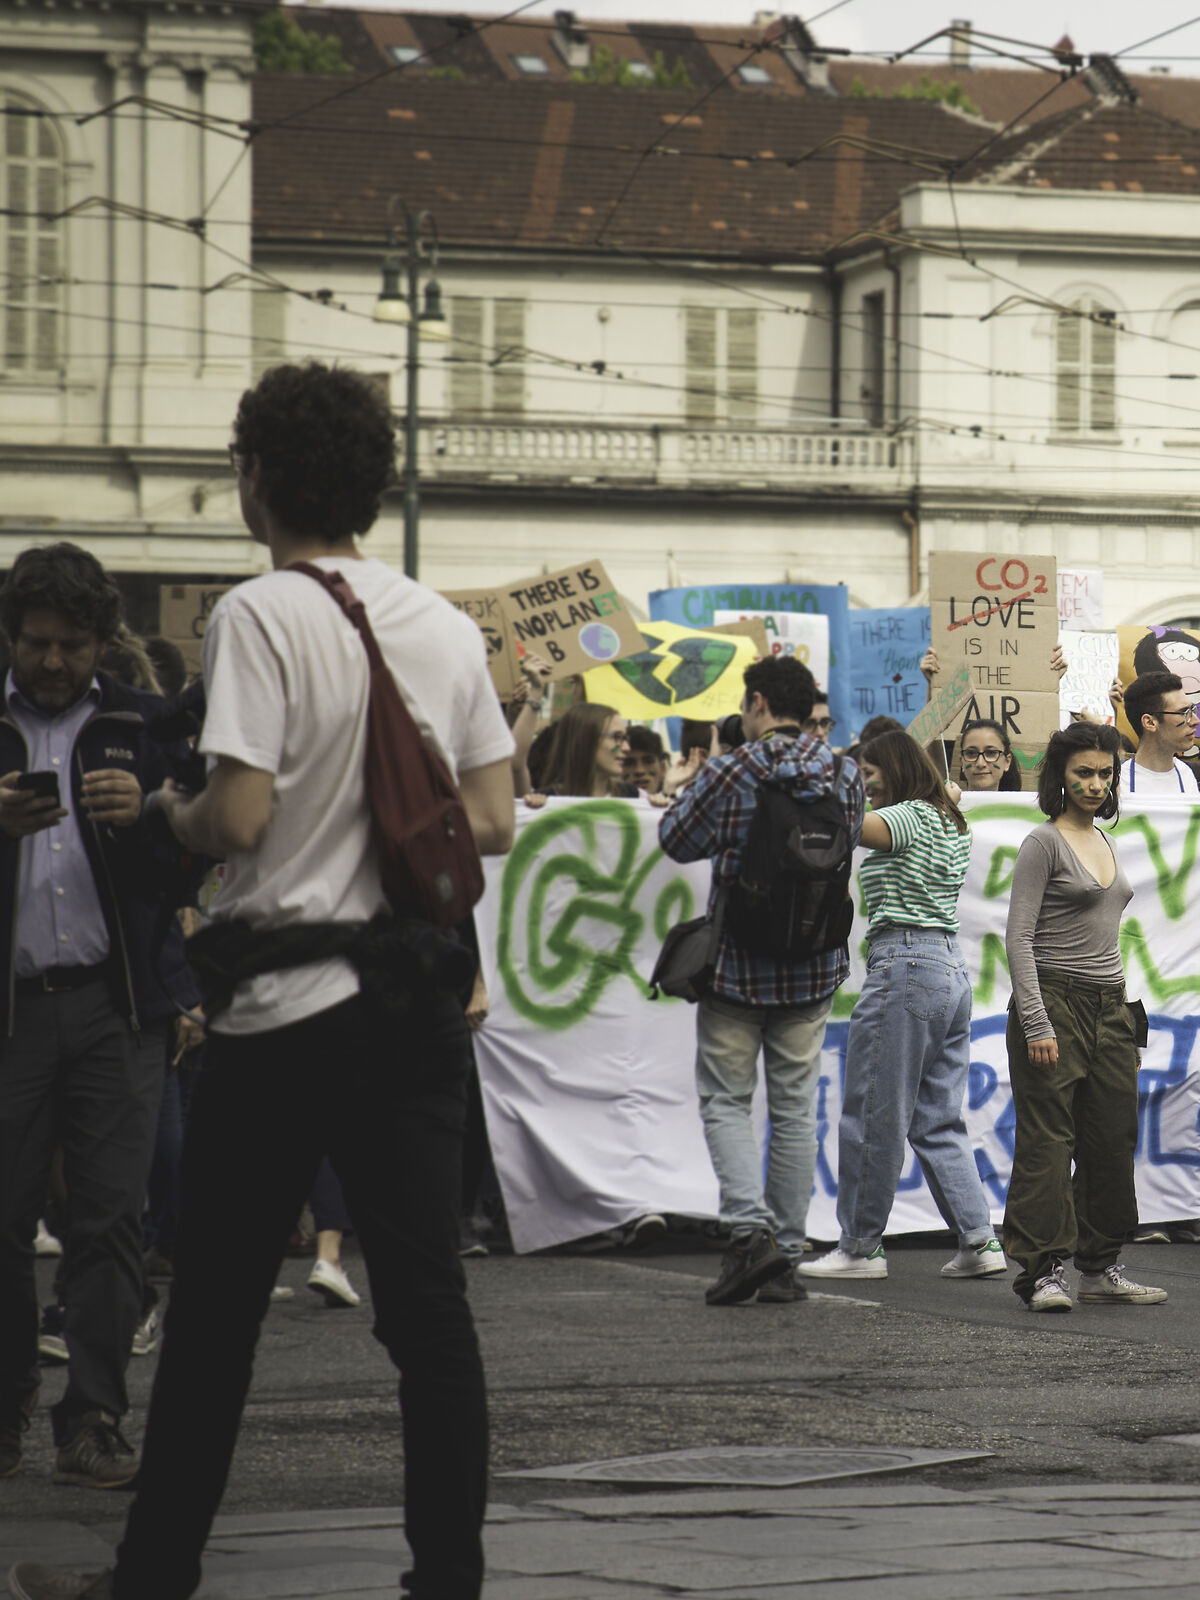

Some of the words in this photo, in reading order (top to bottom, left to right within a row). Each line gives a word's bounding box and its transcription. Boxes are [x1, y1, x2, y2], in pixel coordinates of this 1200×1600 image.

[509, 575, 577, 611] THERE
[576, 568, 600, 591] IS
[950, 595, 1036, 630] LOVE
[853, 616, 905, 647] THERE
[963, 637, 983, 656] IS
[999, 638, 1019, 656] IN
[546, 640, 567, 663] B
[973, 665, 1013, 686] THE
[854, 687, 876, 715] TO
[881, 682, 919, 713] THE
[961, 695, 1023, 735] AIR
